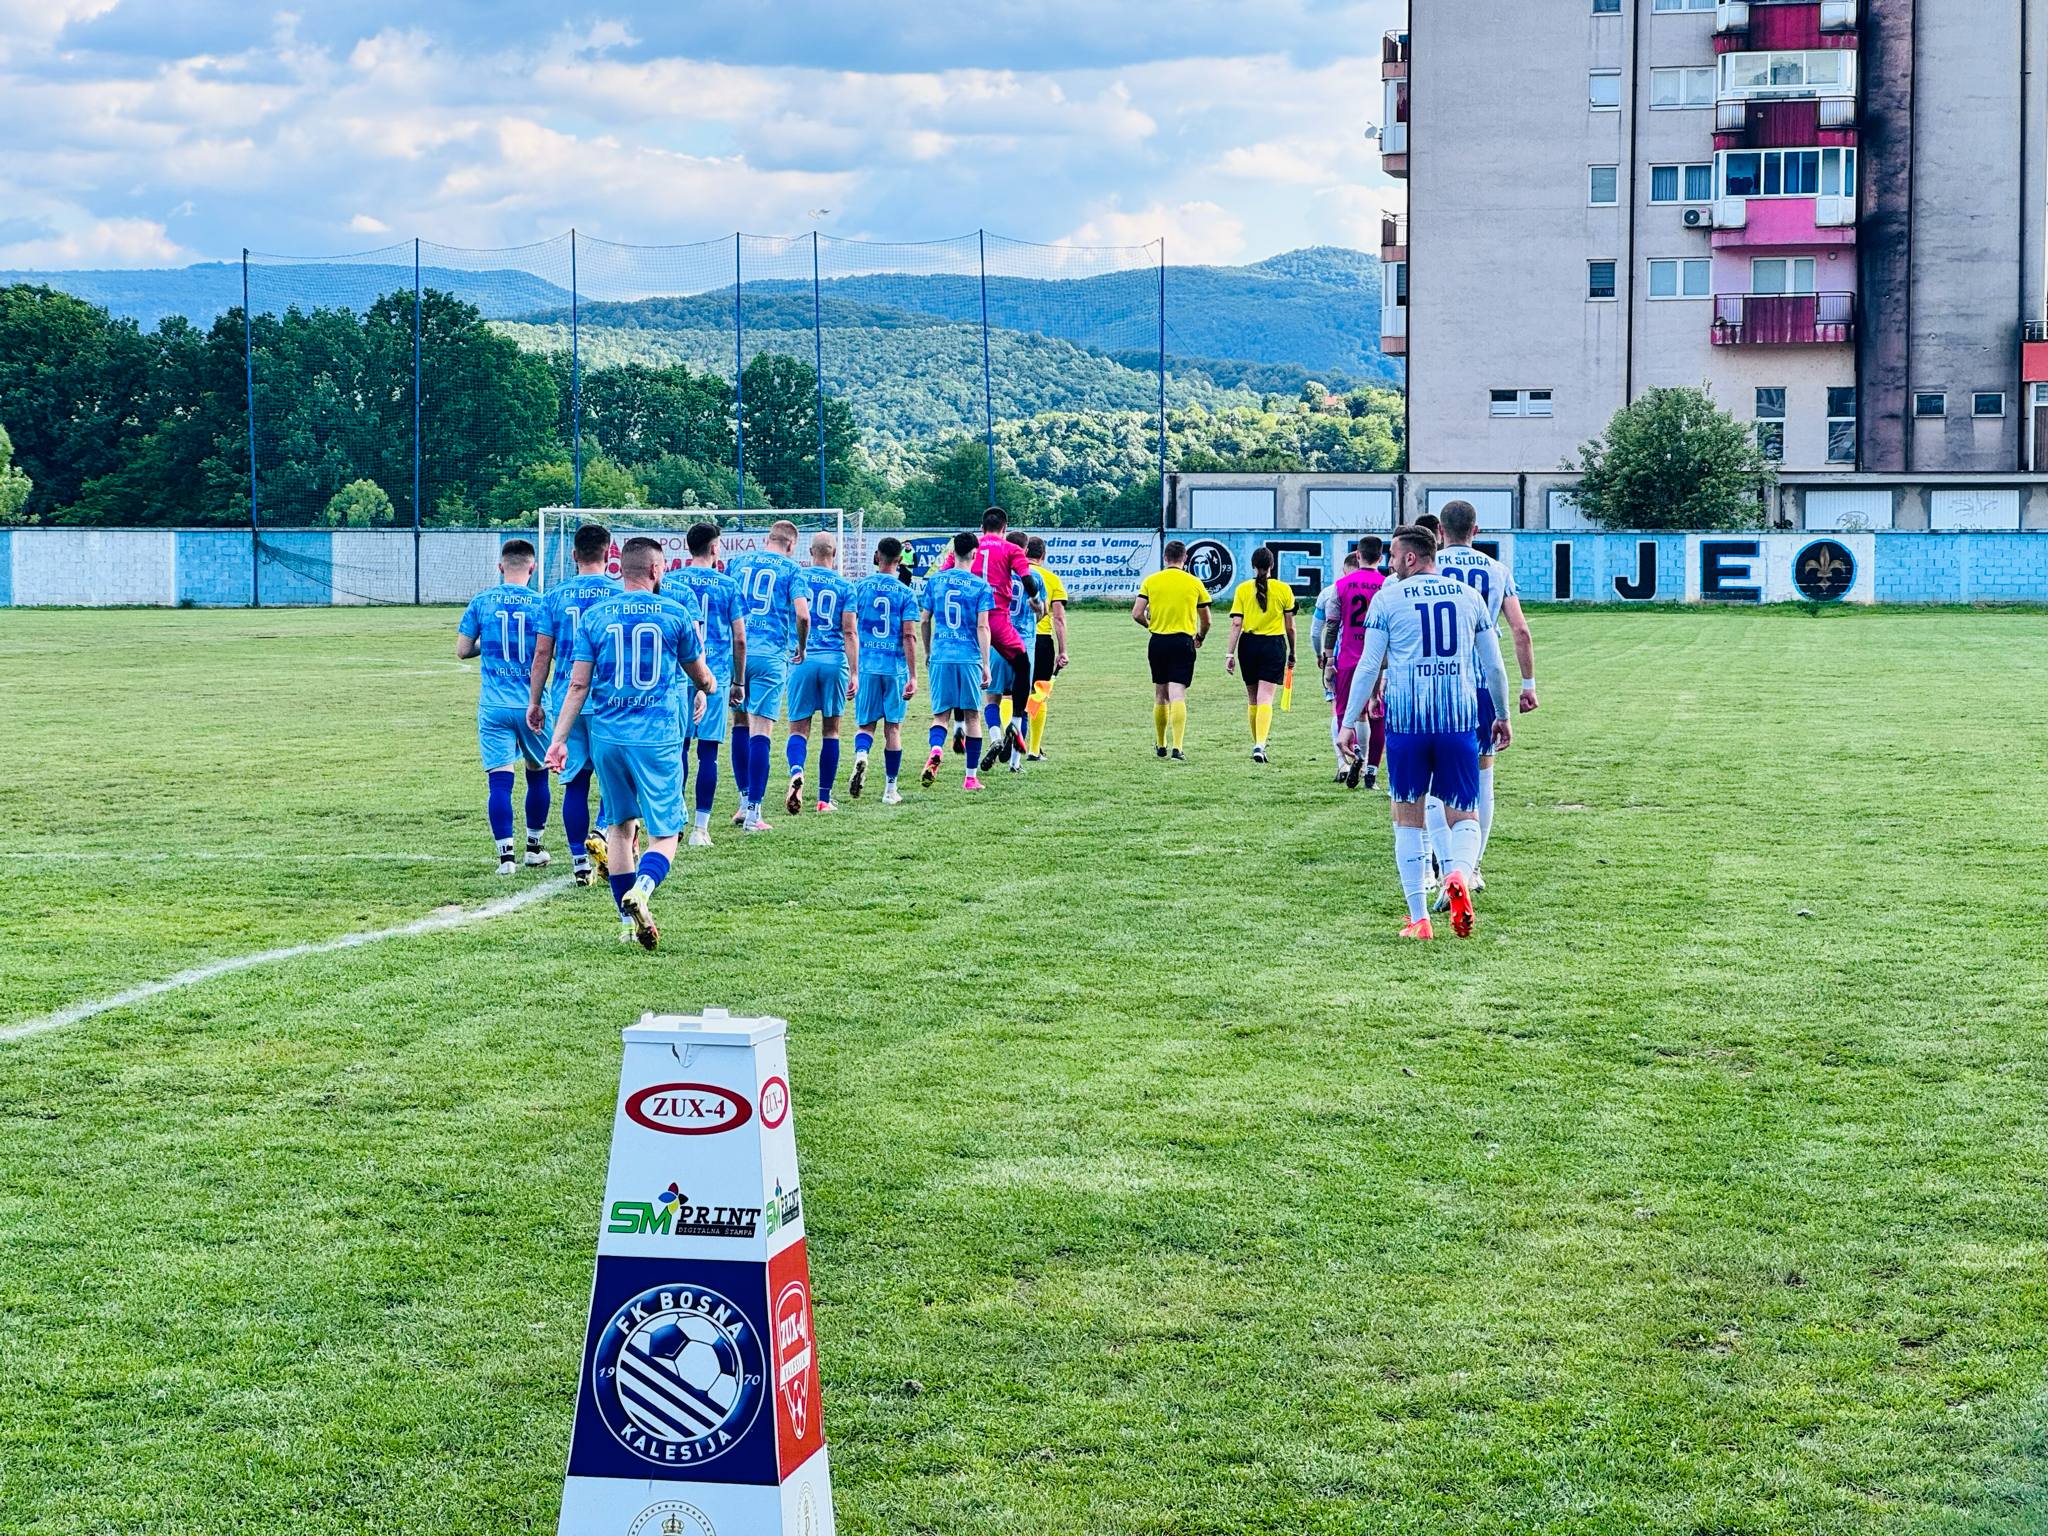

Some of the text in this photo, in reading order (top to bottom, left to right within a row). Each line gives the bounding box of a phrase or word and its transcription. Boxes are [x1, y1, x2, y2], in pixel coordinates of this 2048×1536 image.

[916, 544, 930, 553] PZU
[1081, 539, 1096, 548] sa
[755, 557, 783, 567] BOSNA
[1047, 555, 1127, 565] 035/ 630-854
[1438, 555, 1491, 567] FK SLOGA
[1221, 564, 1232, 573] 93
[679, 575, 719, 587] FK BOSNA
[811, 575, 836, 585] BOSNA
[948, 577, 972, 587] BOSNA
[1348, 581, 1359, 591] FK
[563, 587, 611, 599] FK BOSNA
[740, 566, 777, 616] 19
[877, 582, 900, 593] BOSNA
[1404, 584, 1463, 598] FK SLOGA
[490, 594, 533, 605] FK BOSNA
[604, 603, 662, 616] FK BOSNA
[944, 589, 962, 630] 6
[872, 596, 891, 639] 3
[1414, 601, 1458, 657] 10
[494, 610, 526, 664] 11
[605, 622, 663, 691] 10
[1416, 660, 1460, 677] TOJŠIĆI
[653, 1097, 726, 1119] ZUX-4
[765, 1090, 783, 1115] ZUX-4
[607, 1201, 673, 1235] SM
[677, 1205, 761, 1228] PRINT
[766, 1199, 782, 1238] SM
[781, 1187, 800, 1213] PRINT
[677, 1226, 721, 1236] DIGITALNA
[615, 1291, 744, 1340] FK BOSNA
[780, 1308, 806, 1350] ZUX-4
[598, 1366, 761, 1386] 19 70
[620, 1422, 733, 1461] KALESIJA
